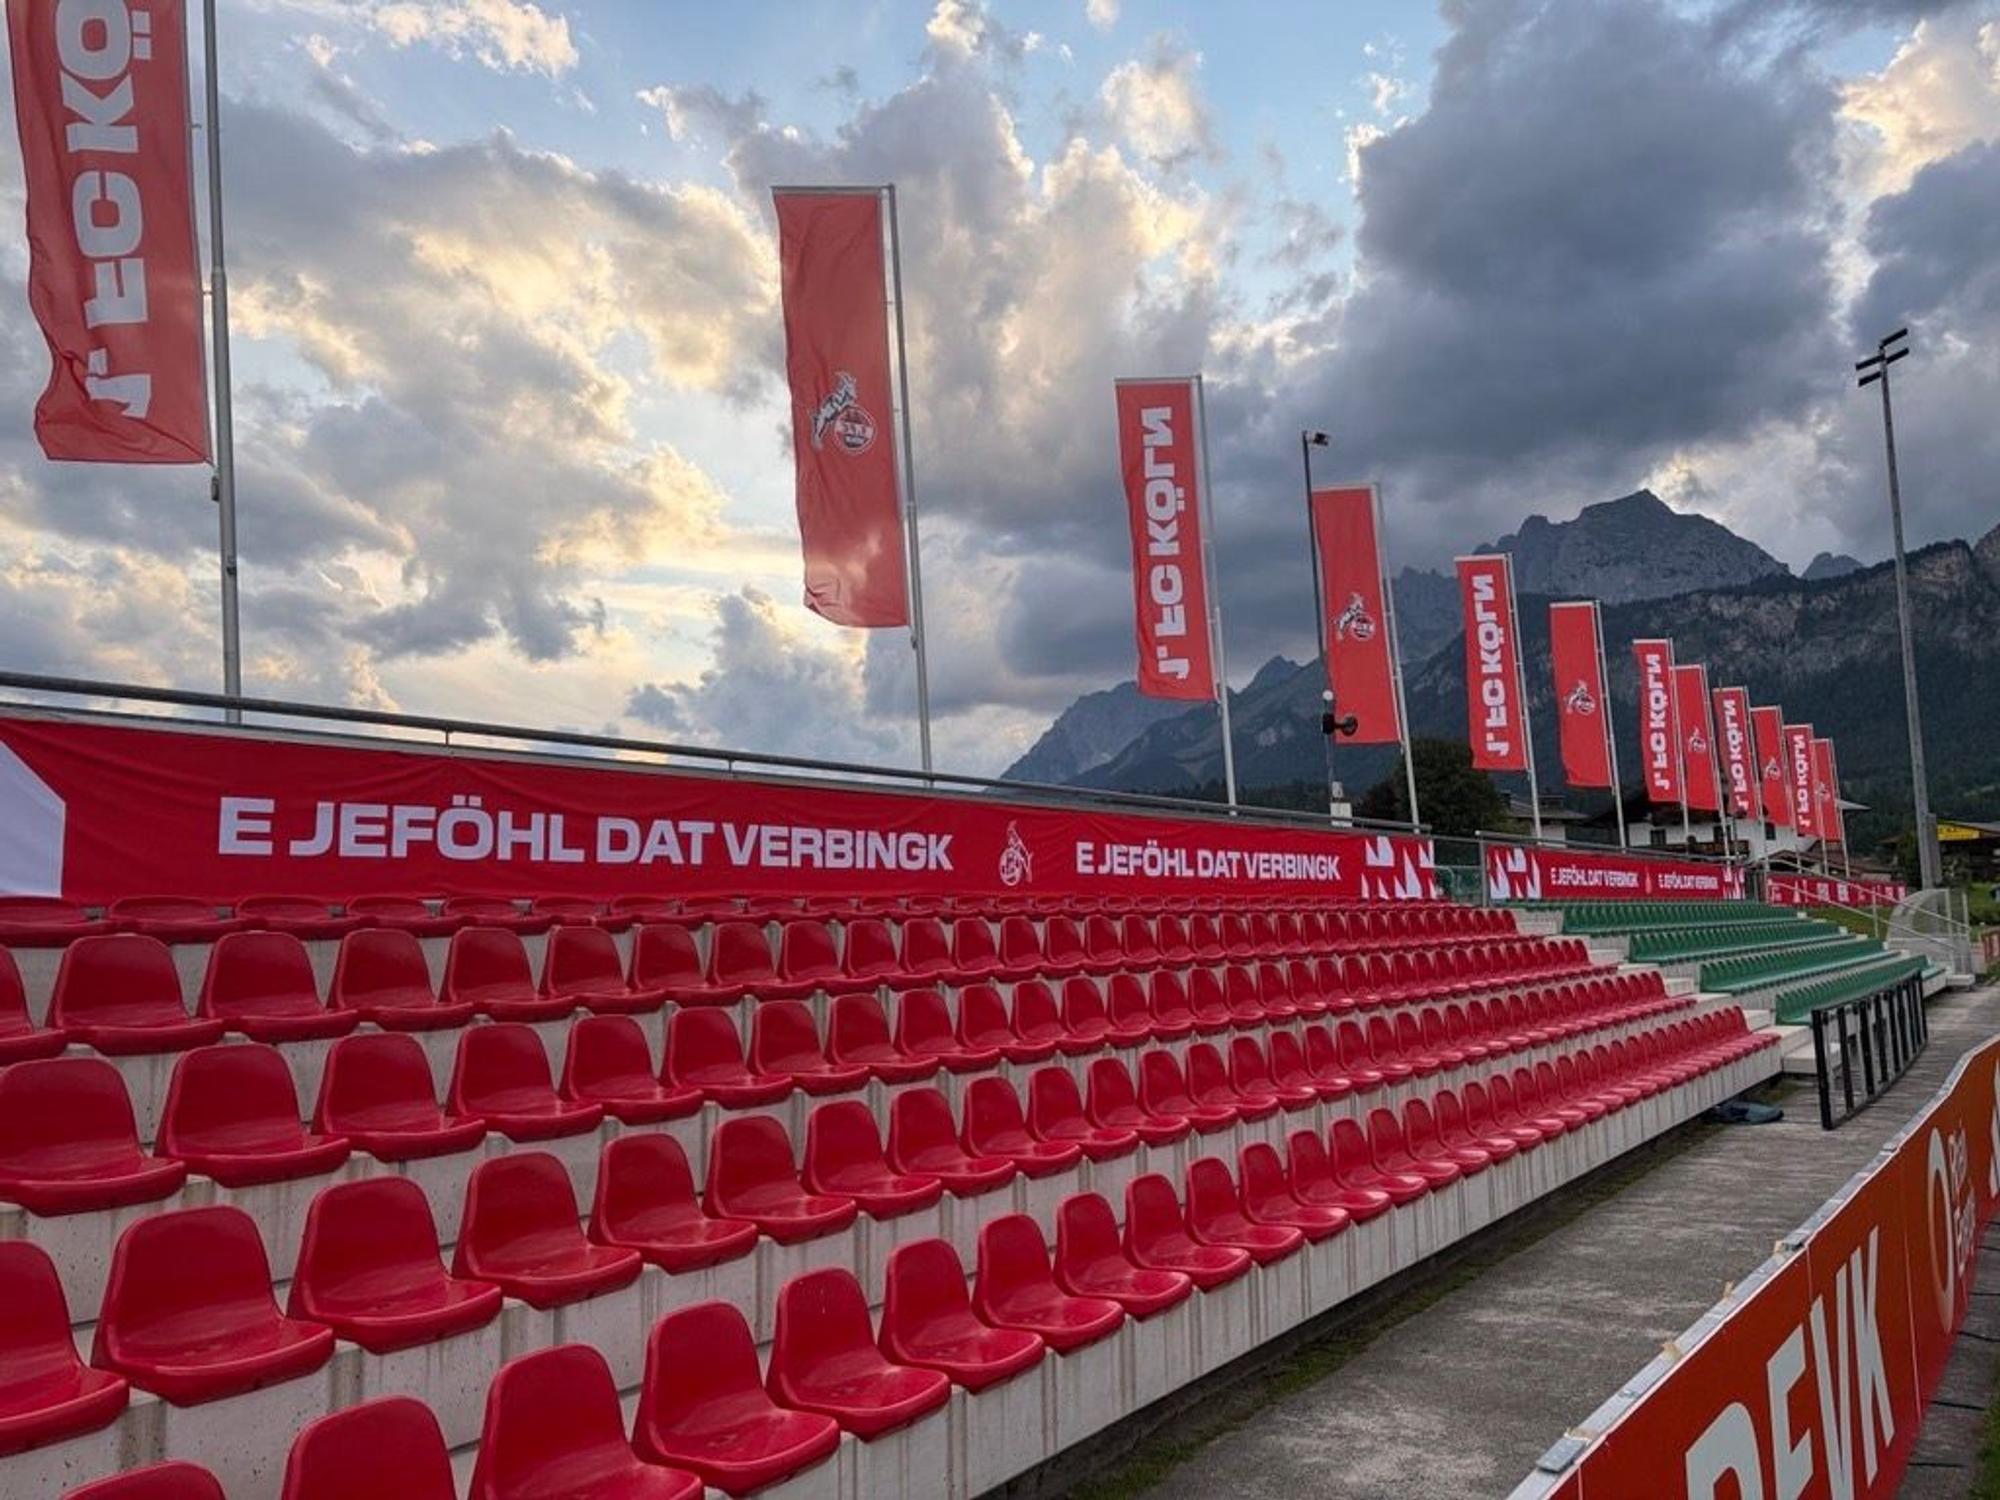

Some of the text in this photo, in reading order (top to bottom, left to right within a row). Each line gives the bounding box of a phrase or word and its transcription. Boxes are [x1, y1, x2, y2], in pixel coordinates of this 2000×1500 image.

[218, 796, 275, 855] E
[289, 794, 585, 863] JEFÖHL
[596, 816, 714, 866] DAT
[722, 822, 954, 871] VERBINGK
[1076, 840, 1342, 881] E JEFÖHL DAT VERBINGK
